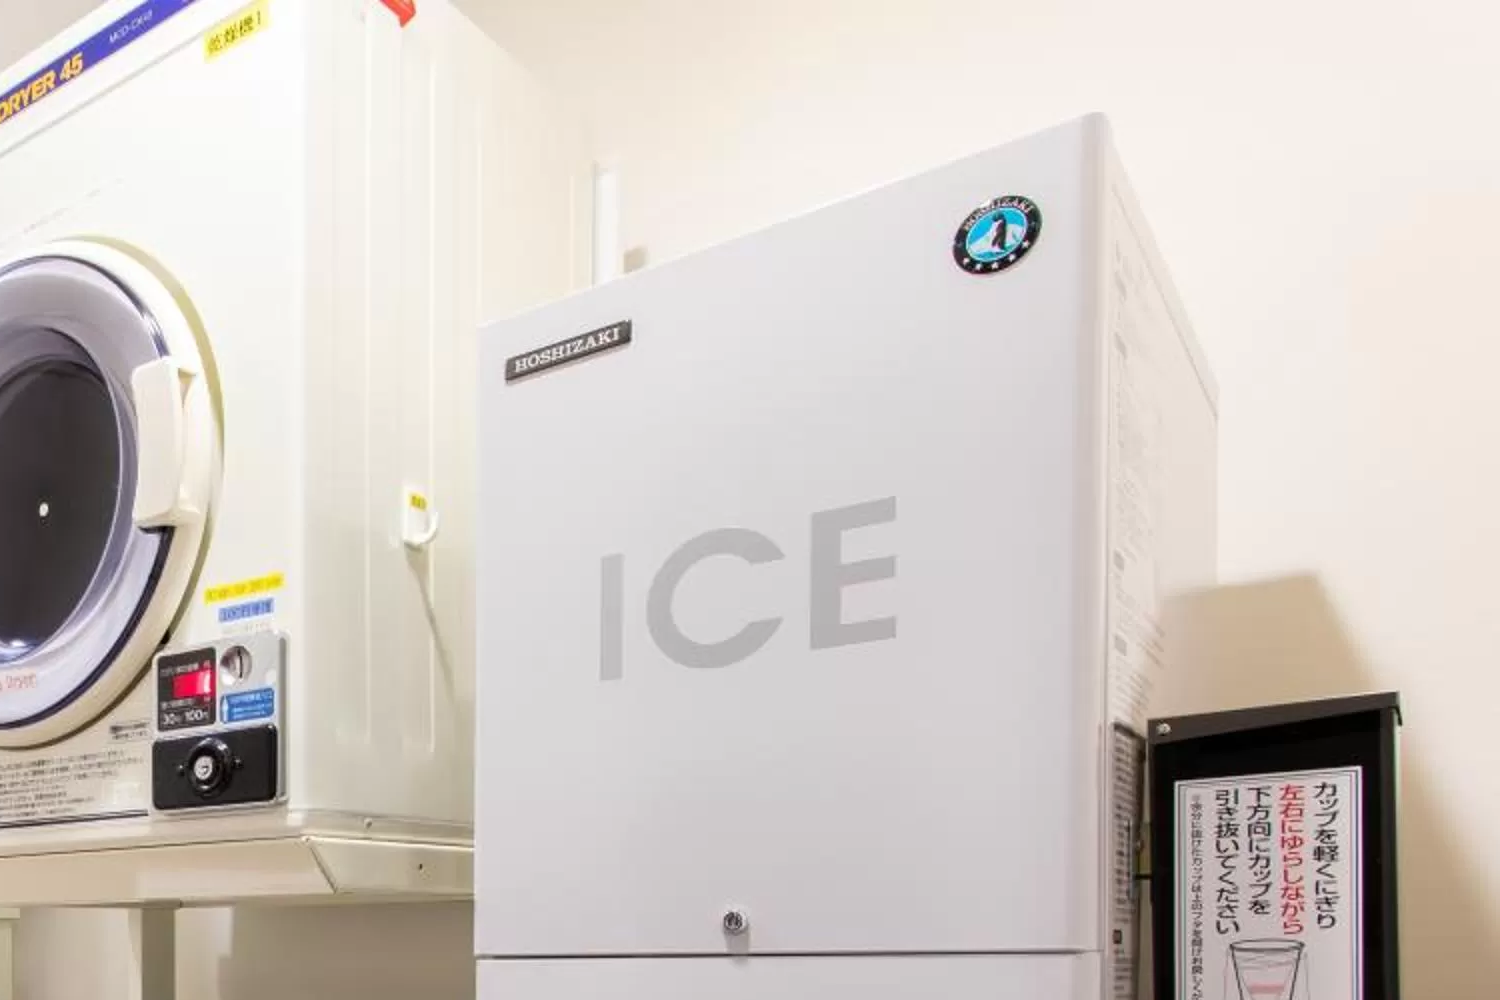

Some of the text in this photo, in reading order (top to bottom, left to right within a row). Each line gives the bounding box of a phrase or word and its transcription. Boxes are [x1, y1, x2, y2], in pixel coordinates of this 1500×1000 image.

[59, 52, 83, 81] 45
[514, 326, 621, 373] HOSHIZAKI
[600, 496, 897, 681] ICE
[1214, 788, 1241, 936] 引き抜いてください
[1246, 787, 1273, 916] 下方向にカップを
[1278, 783, 1305, 936] 左右にゆらしながら
[1312, 781, 1340, 930] カップを軽くにぎり
